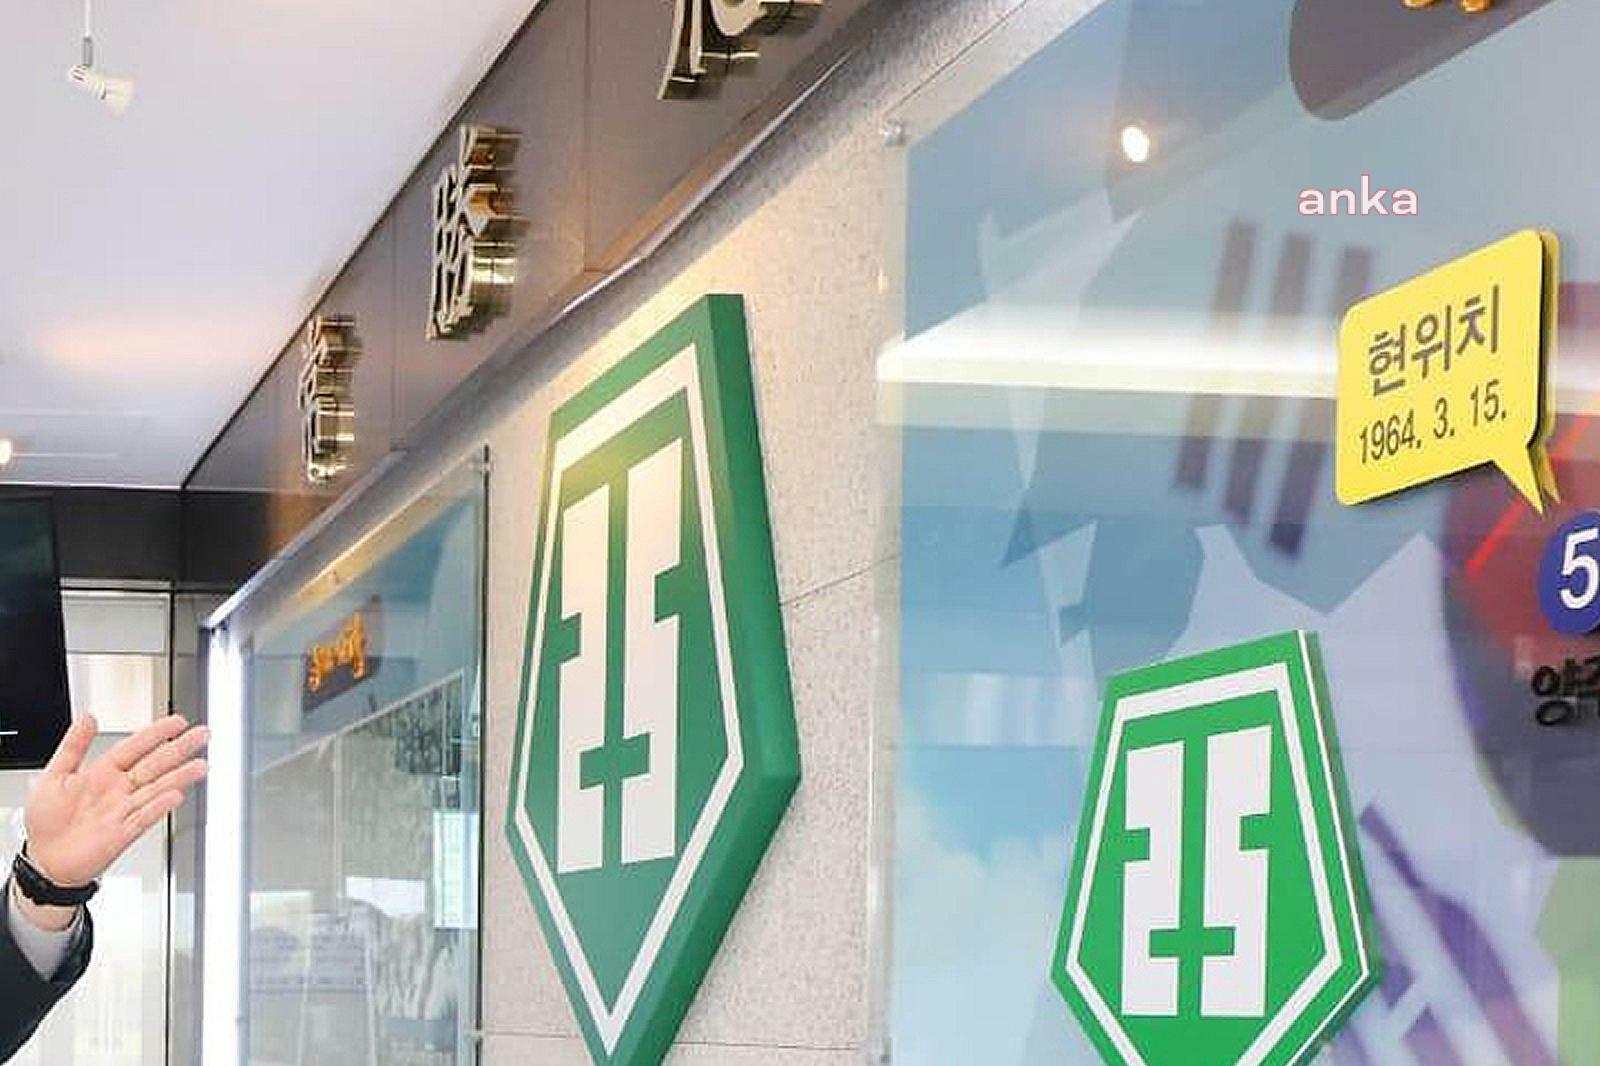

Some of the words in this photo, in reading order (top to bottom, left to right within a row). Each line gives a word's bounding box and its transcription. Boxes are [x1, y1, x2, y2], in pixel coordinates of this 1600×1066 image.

[1367, 284, 1500, 398] 현위치
[1359, 409, 1422, 465] 1964.
[1432, 396, 1456, 439] 3.
[1470, 378, 1508, 427] 15.
